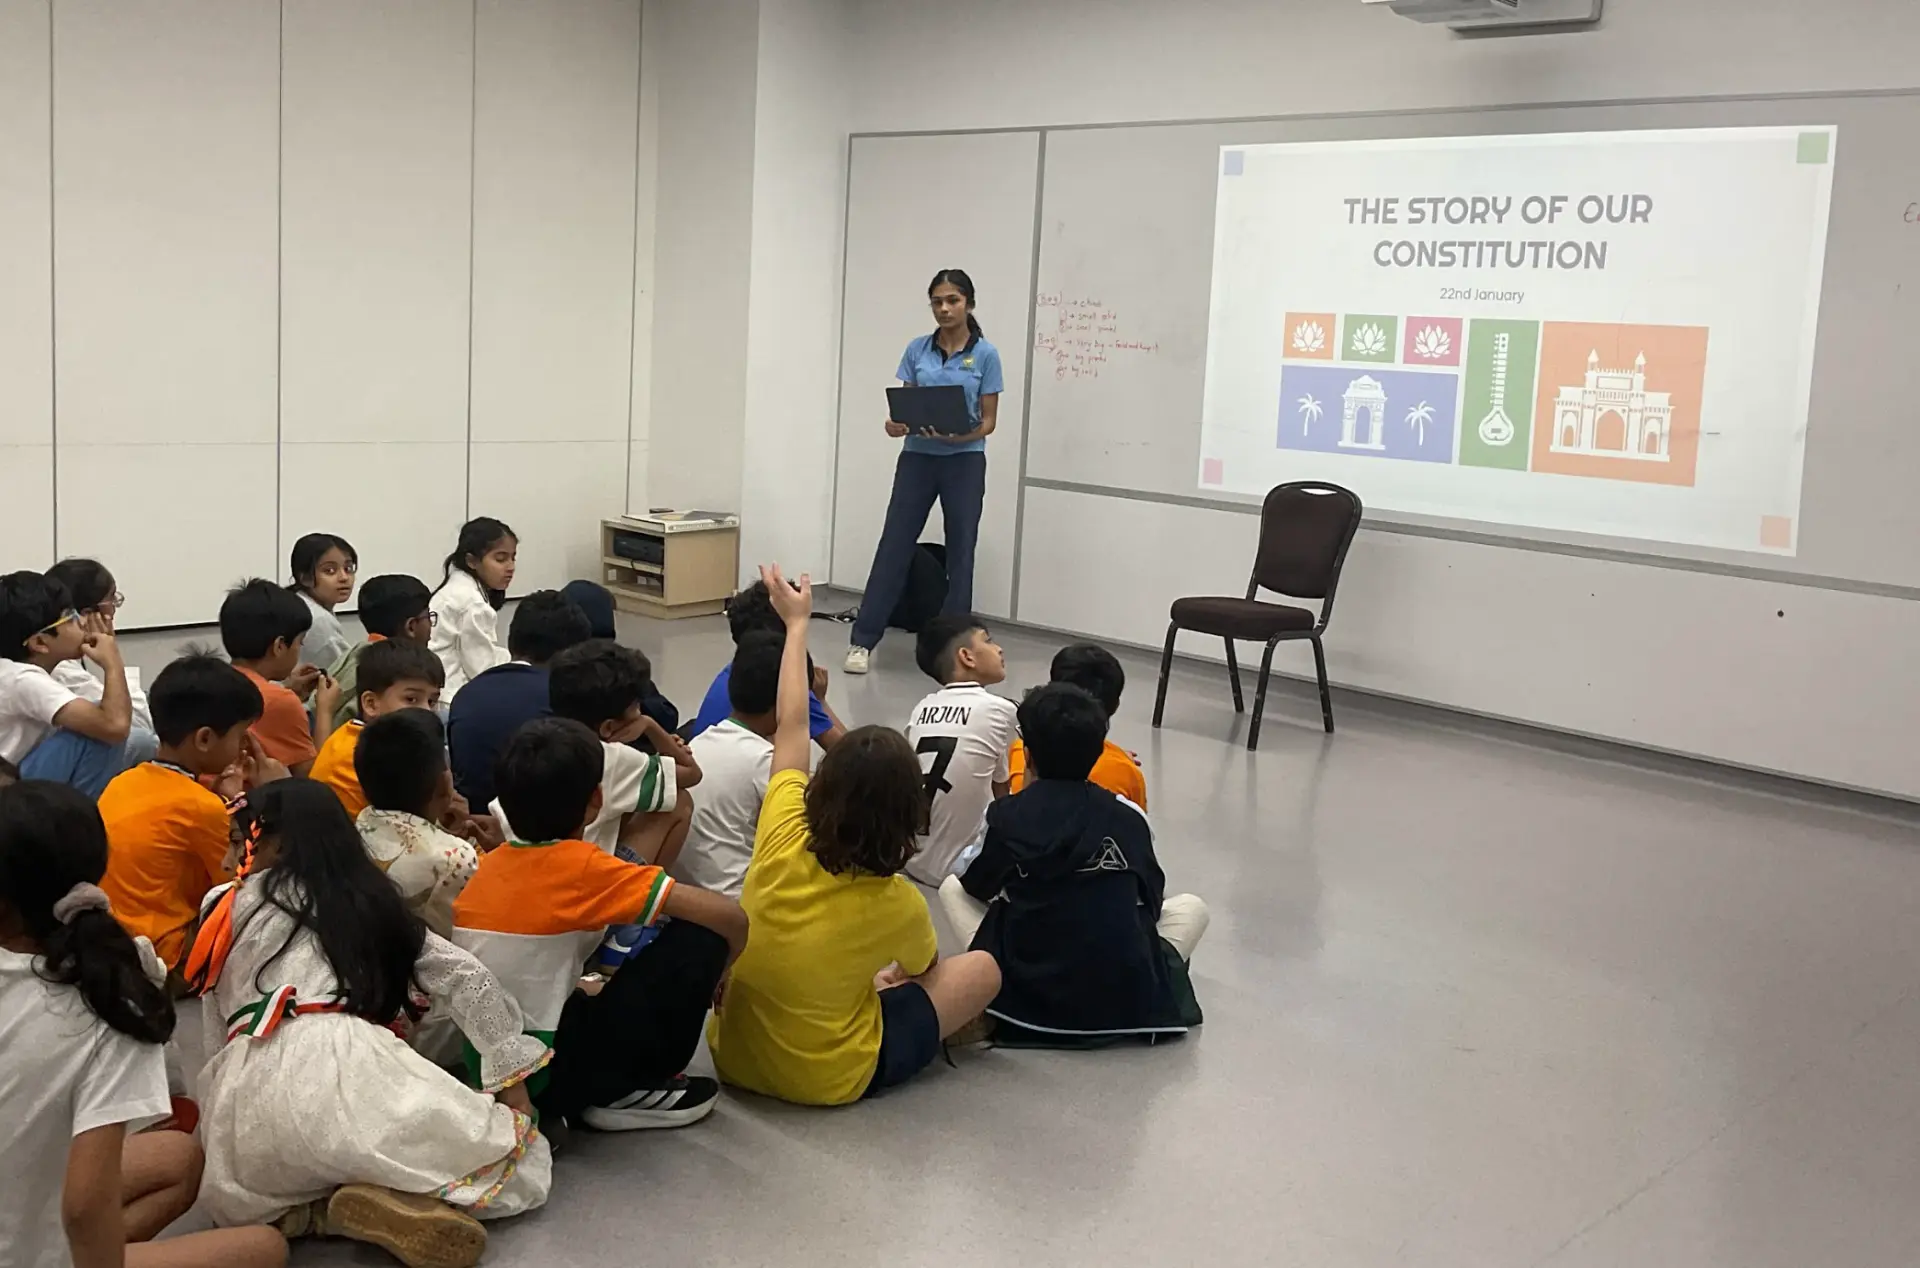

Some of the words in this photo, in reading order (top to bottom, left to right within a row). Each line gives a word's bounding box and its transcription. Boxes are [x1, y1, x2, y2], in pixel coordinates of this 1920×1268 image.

[1344, 197, 1399, 224] THE
[1408, 196, 1512, 224] STORY
[1521, 195, 1568, 224] OF
[1577, 194, 1653, 224] OUR
[1373, 240, 1608, 269] CONSTITUTION
[1440, 288, 1471, 301] 22nd
[1474, 288, 1525, 304] January
[916, 706, 972, 726] ARJUN
[915, 736, 959, 836] 7
